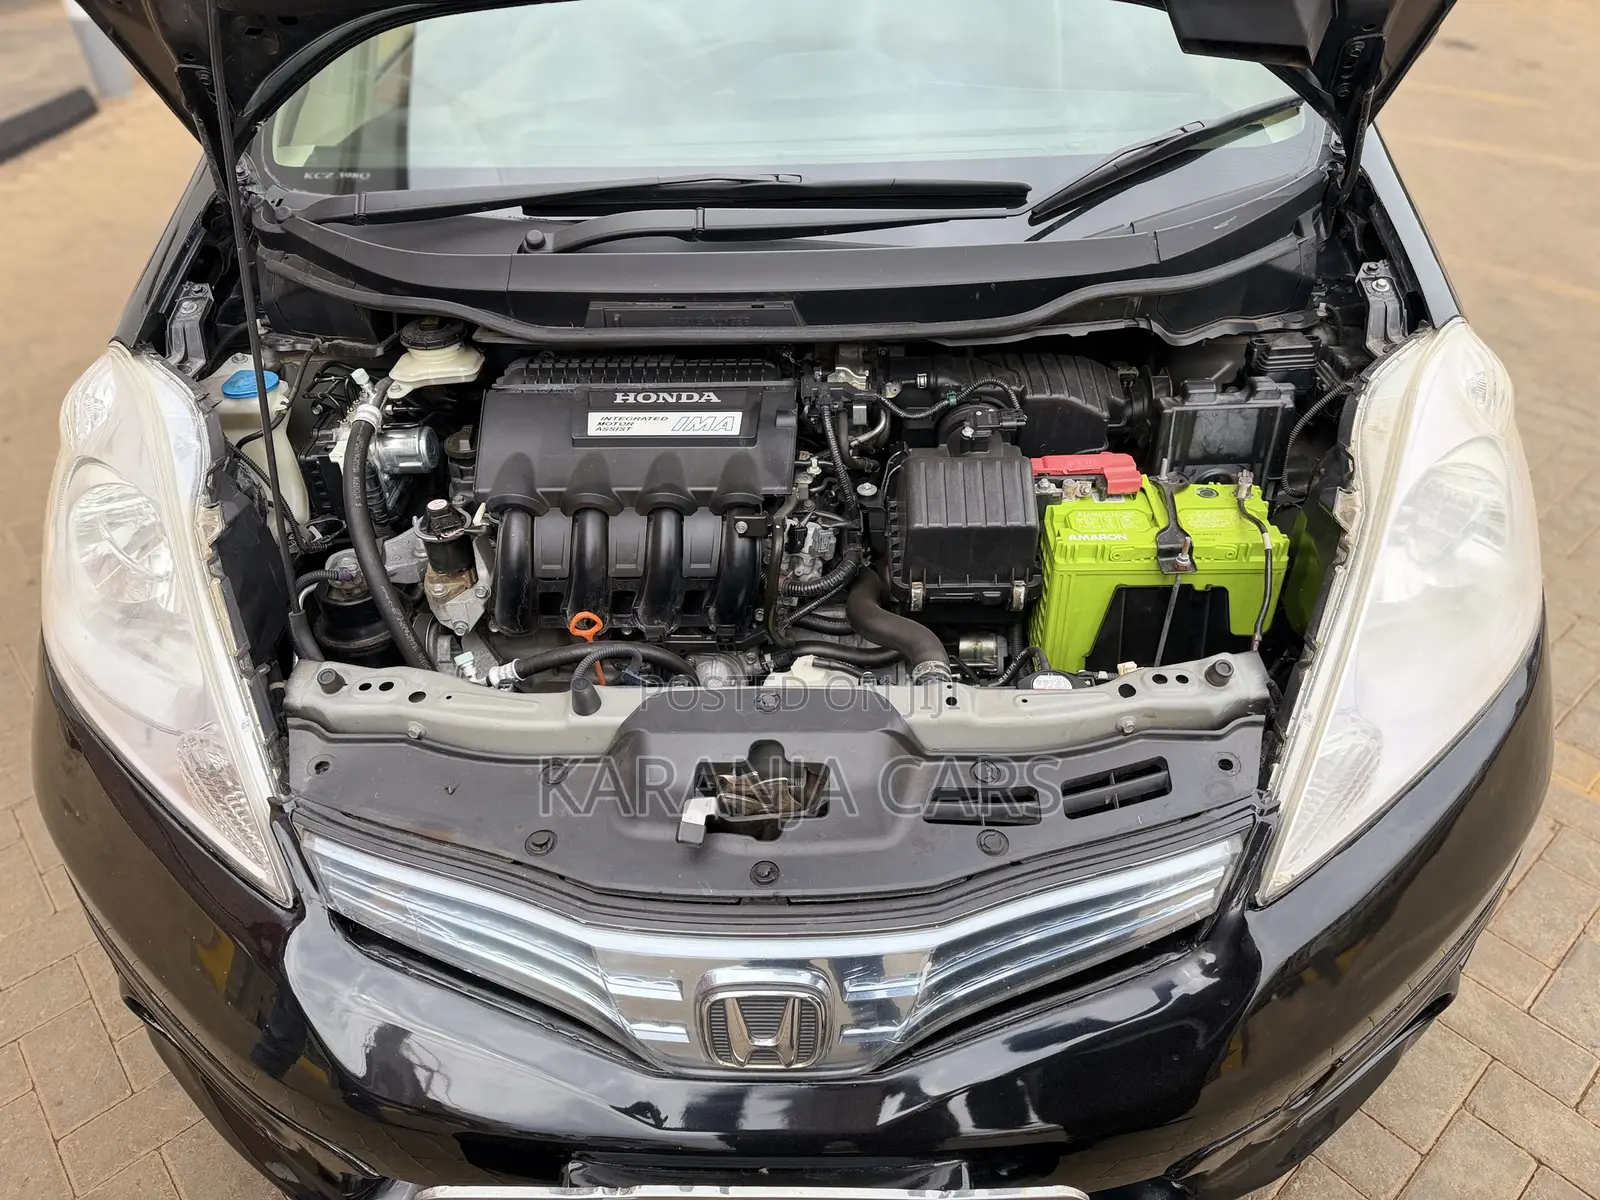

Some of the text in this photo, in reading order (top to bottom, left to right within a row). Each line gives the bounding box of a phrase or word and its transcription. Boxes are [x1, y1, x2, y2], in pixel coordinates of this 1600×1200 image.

[613, 392, 722, 404] HONDA
[671, 416, 736, 432] IMA
[1068, 533, 1128, 541] AMARON
